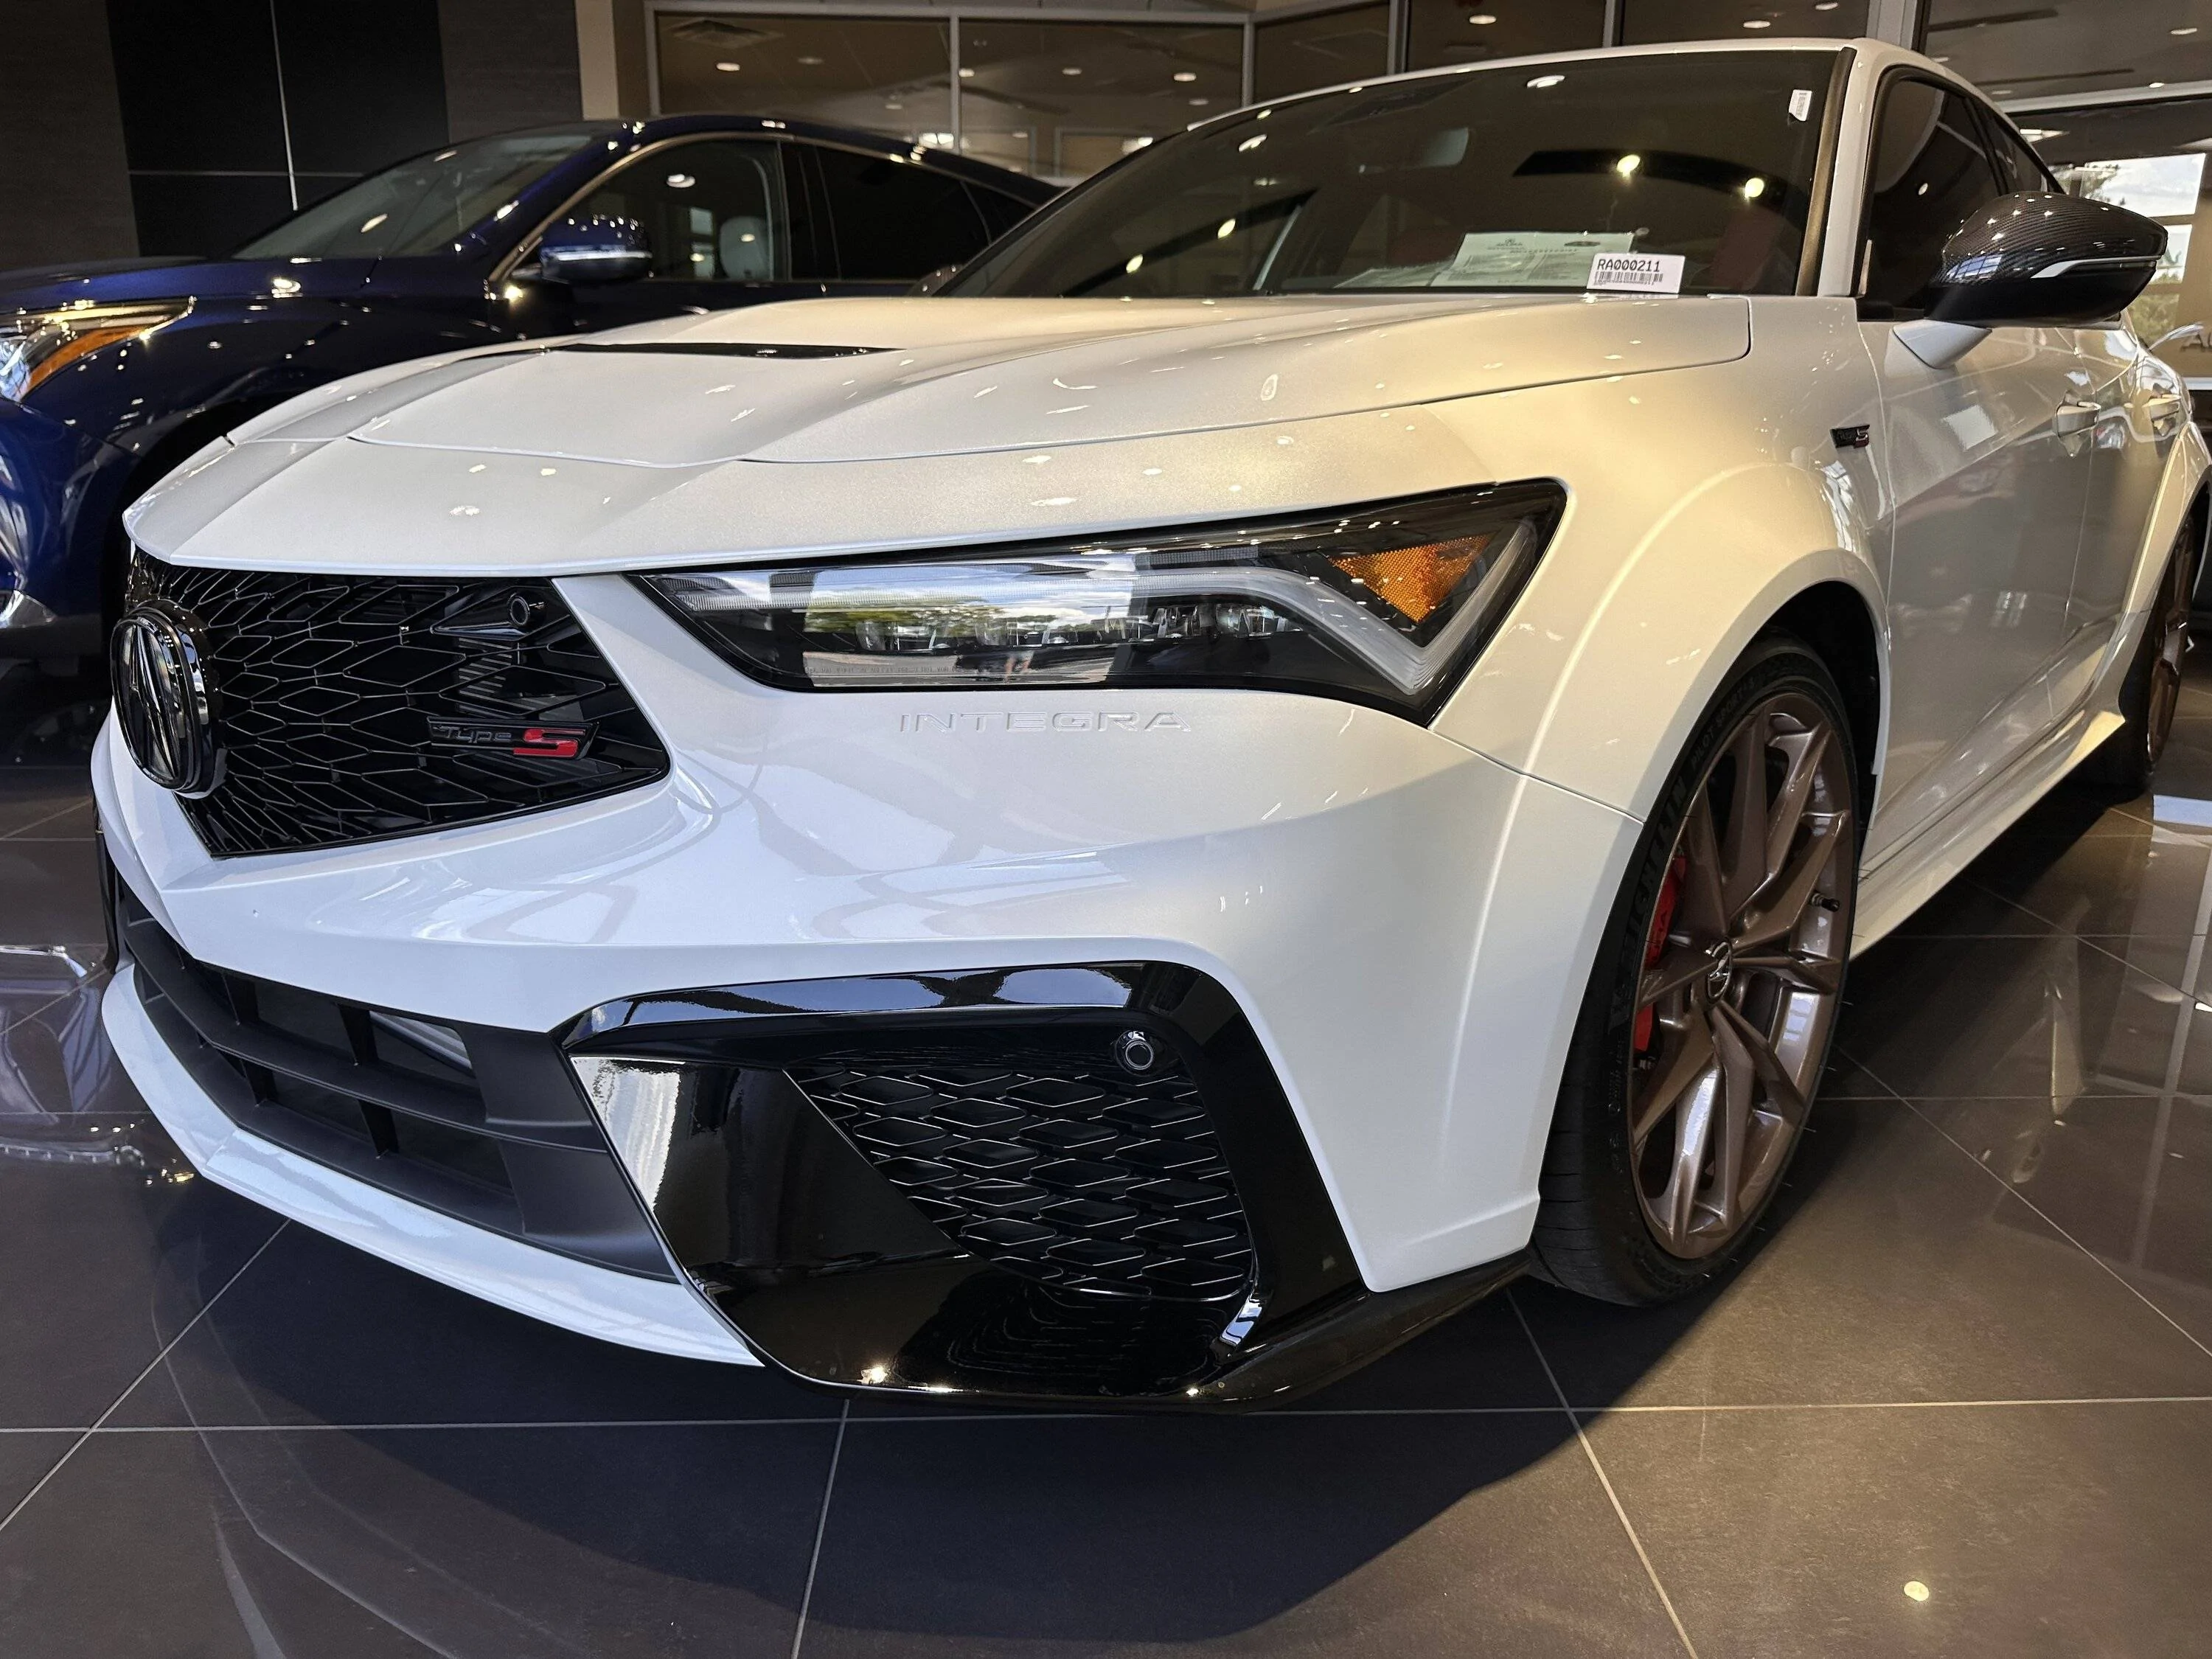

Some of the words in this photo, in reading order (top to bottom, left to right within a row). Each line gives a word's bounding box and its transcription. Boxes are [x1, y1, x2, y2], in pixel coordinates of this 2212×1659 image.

[1597, 258, 1660, 273] RA000211
[899, 711, 1192, 733] INTEGRA
[433, 726, 512, 744] Type
[512, 727, 586, 757] S
